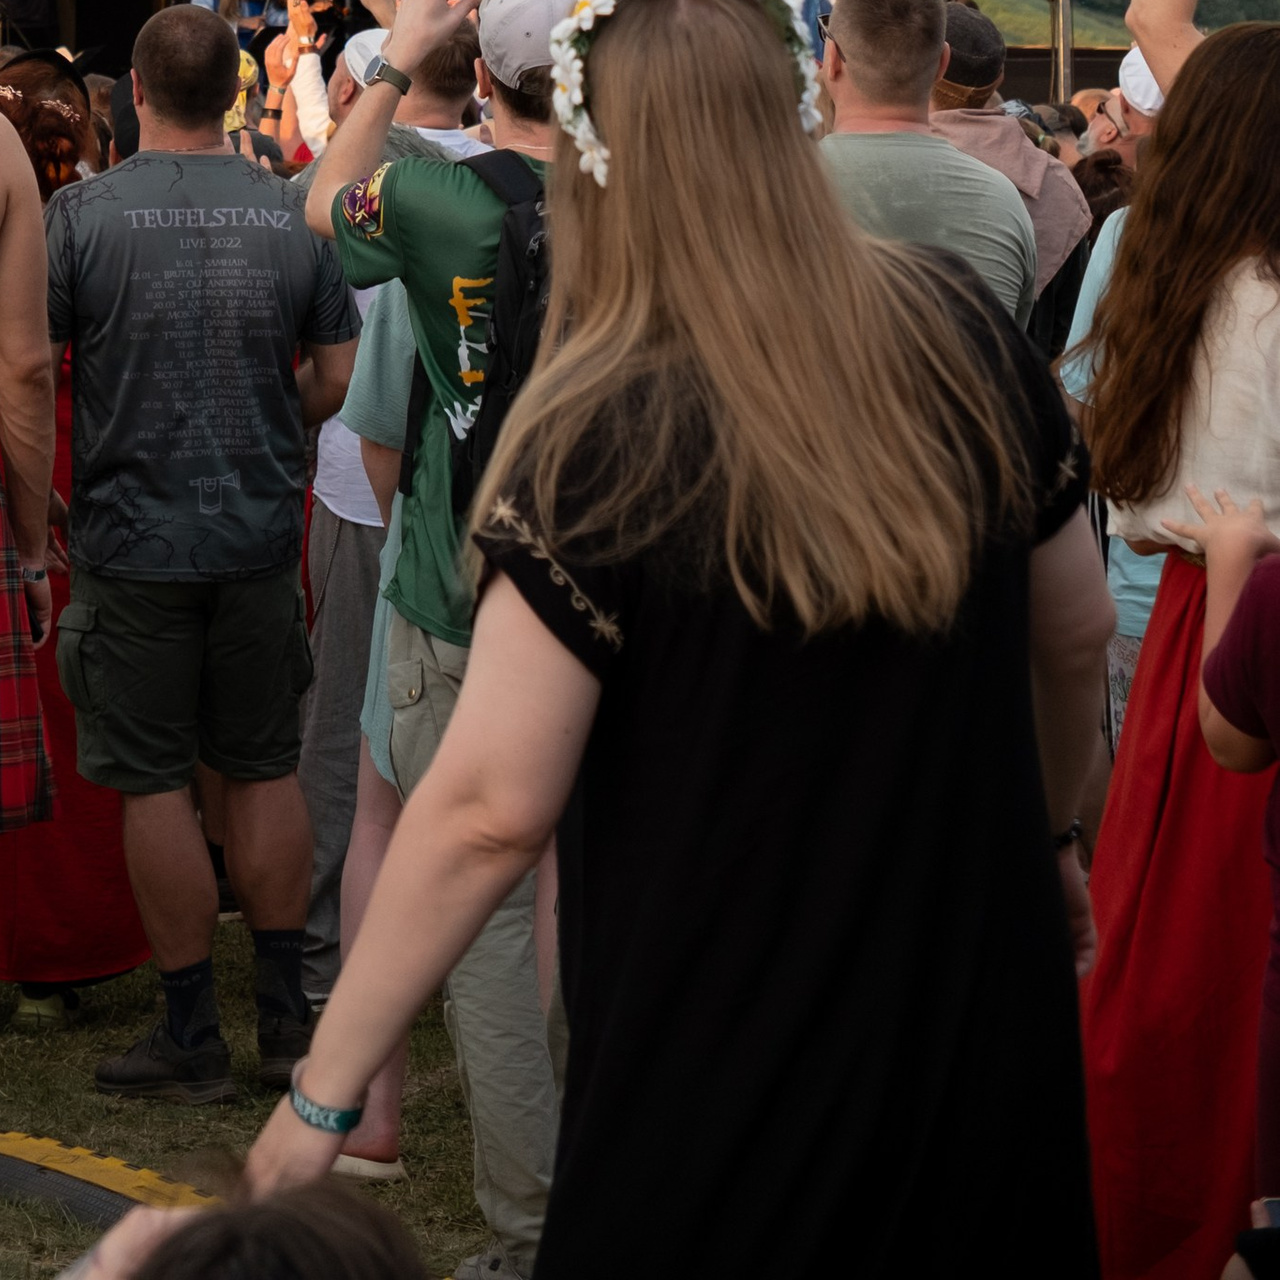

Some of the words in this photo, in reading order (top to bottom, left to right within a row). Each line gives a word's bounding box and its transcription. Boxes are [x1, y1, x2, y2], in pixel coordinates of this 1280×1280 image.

[123, 207, 292, 231] TEUFELSTANZ
[179, 238, 207, 249] LIVE
[210, 237, 242, 249] 2022
[204, 258, 248, 268] SAMHAIN
[163, 269, 196, 280] BRUTAL
[199, 269, 244, 279] MEDIEVAL
[255, 279, 275, 290] FEST
[236, 289, 270, 299] FRIDAY
